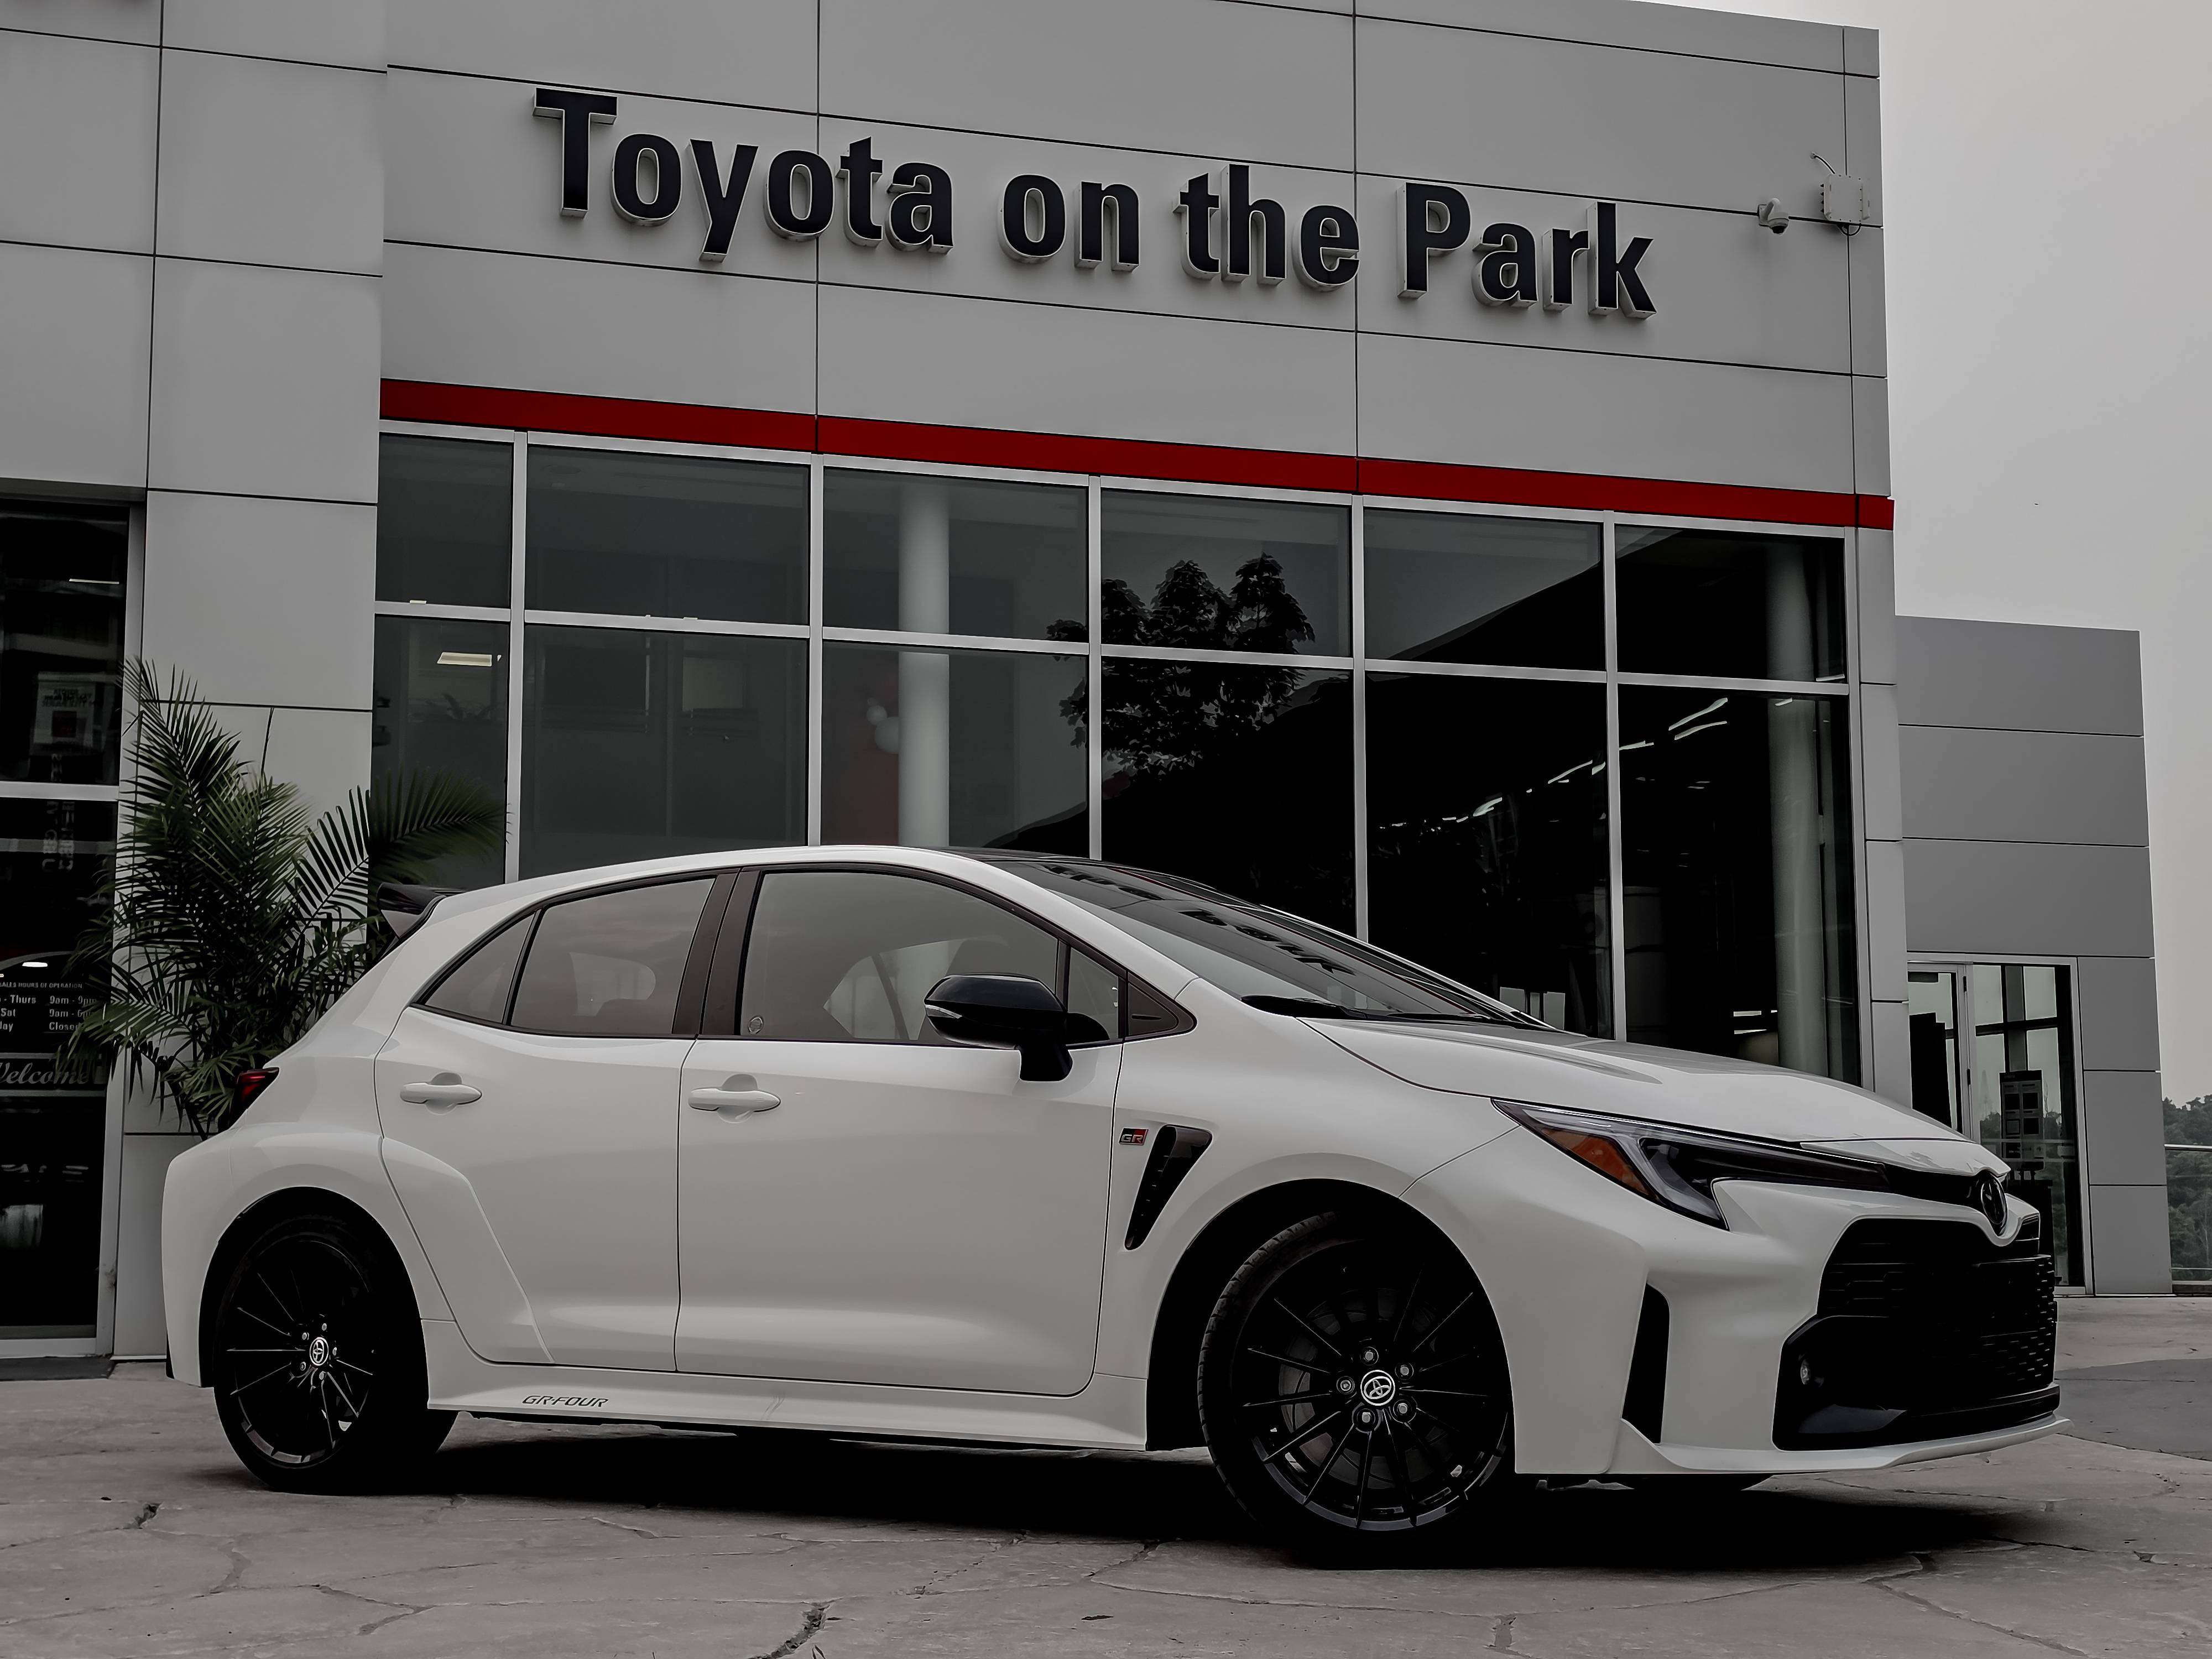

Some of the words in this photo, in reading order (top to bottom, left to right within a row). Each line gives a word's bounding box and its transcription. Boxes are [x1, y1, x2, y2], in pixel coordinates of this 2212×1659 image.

[532, 87, 952, 263] Toyota
[1000, 174, 1139, 272] on
[1173, 163, 1360, 293] the
[1397, 182, 1656, 321] Park
[10, 995, 36, 1004] Thurs
[50, 995, 69, 1004] 9am
[1, 1008, 16, 1017] Sat
[49, 1009, 69, 1017] 9am
[1121, 1134, 1143, 1142] GR
